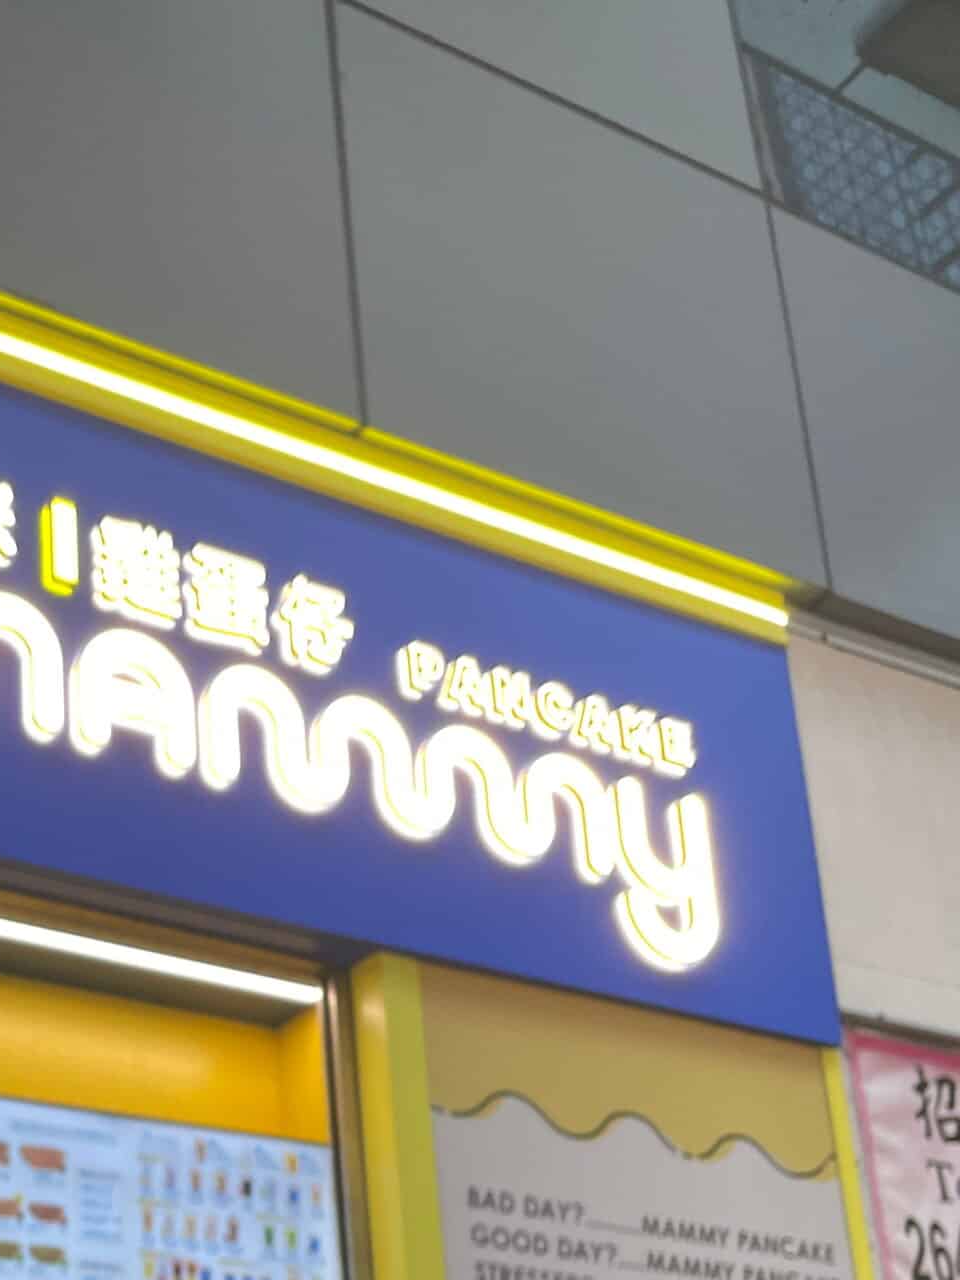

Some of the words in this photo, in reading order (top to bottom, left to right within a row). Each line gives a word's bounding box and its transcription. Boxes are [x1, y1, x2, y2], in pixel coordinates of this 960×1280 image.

[396, 640, 696, 779] PANCAKE
[912, 1062, 960, 1143] 招
[468, 1184, 515, 1215] BAD
[524, 1191, 585, 1226] DAY?
[641, 1213, 729, 1247] MAMMY
[738, 1229, 834, 1265] PANCAKE
[470, 1222, 548, 1257] GOOD
[557, 1235, 618, 1269] DAY?
